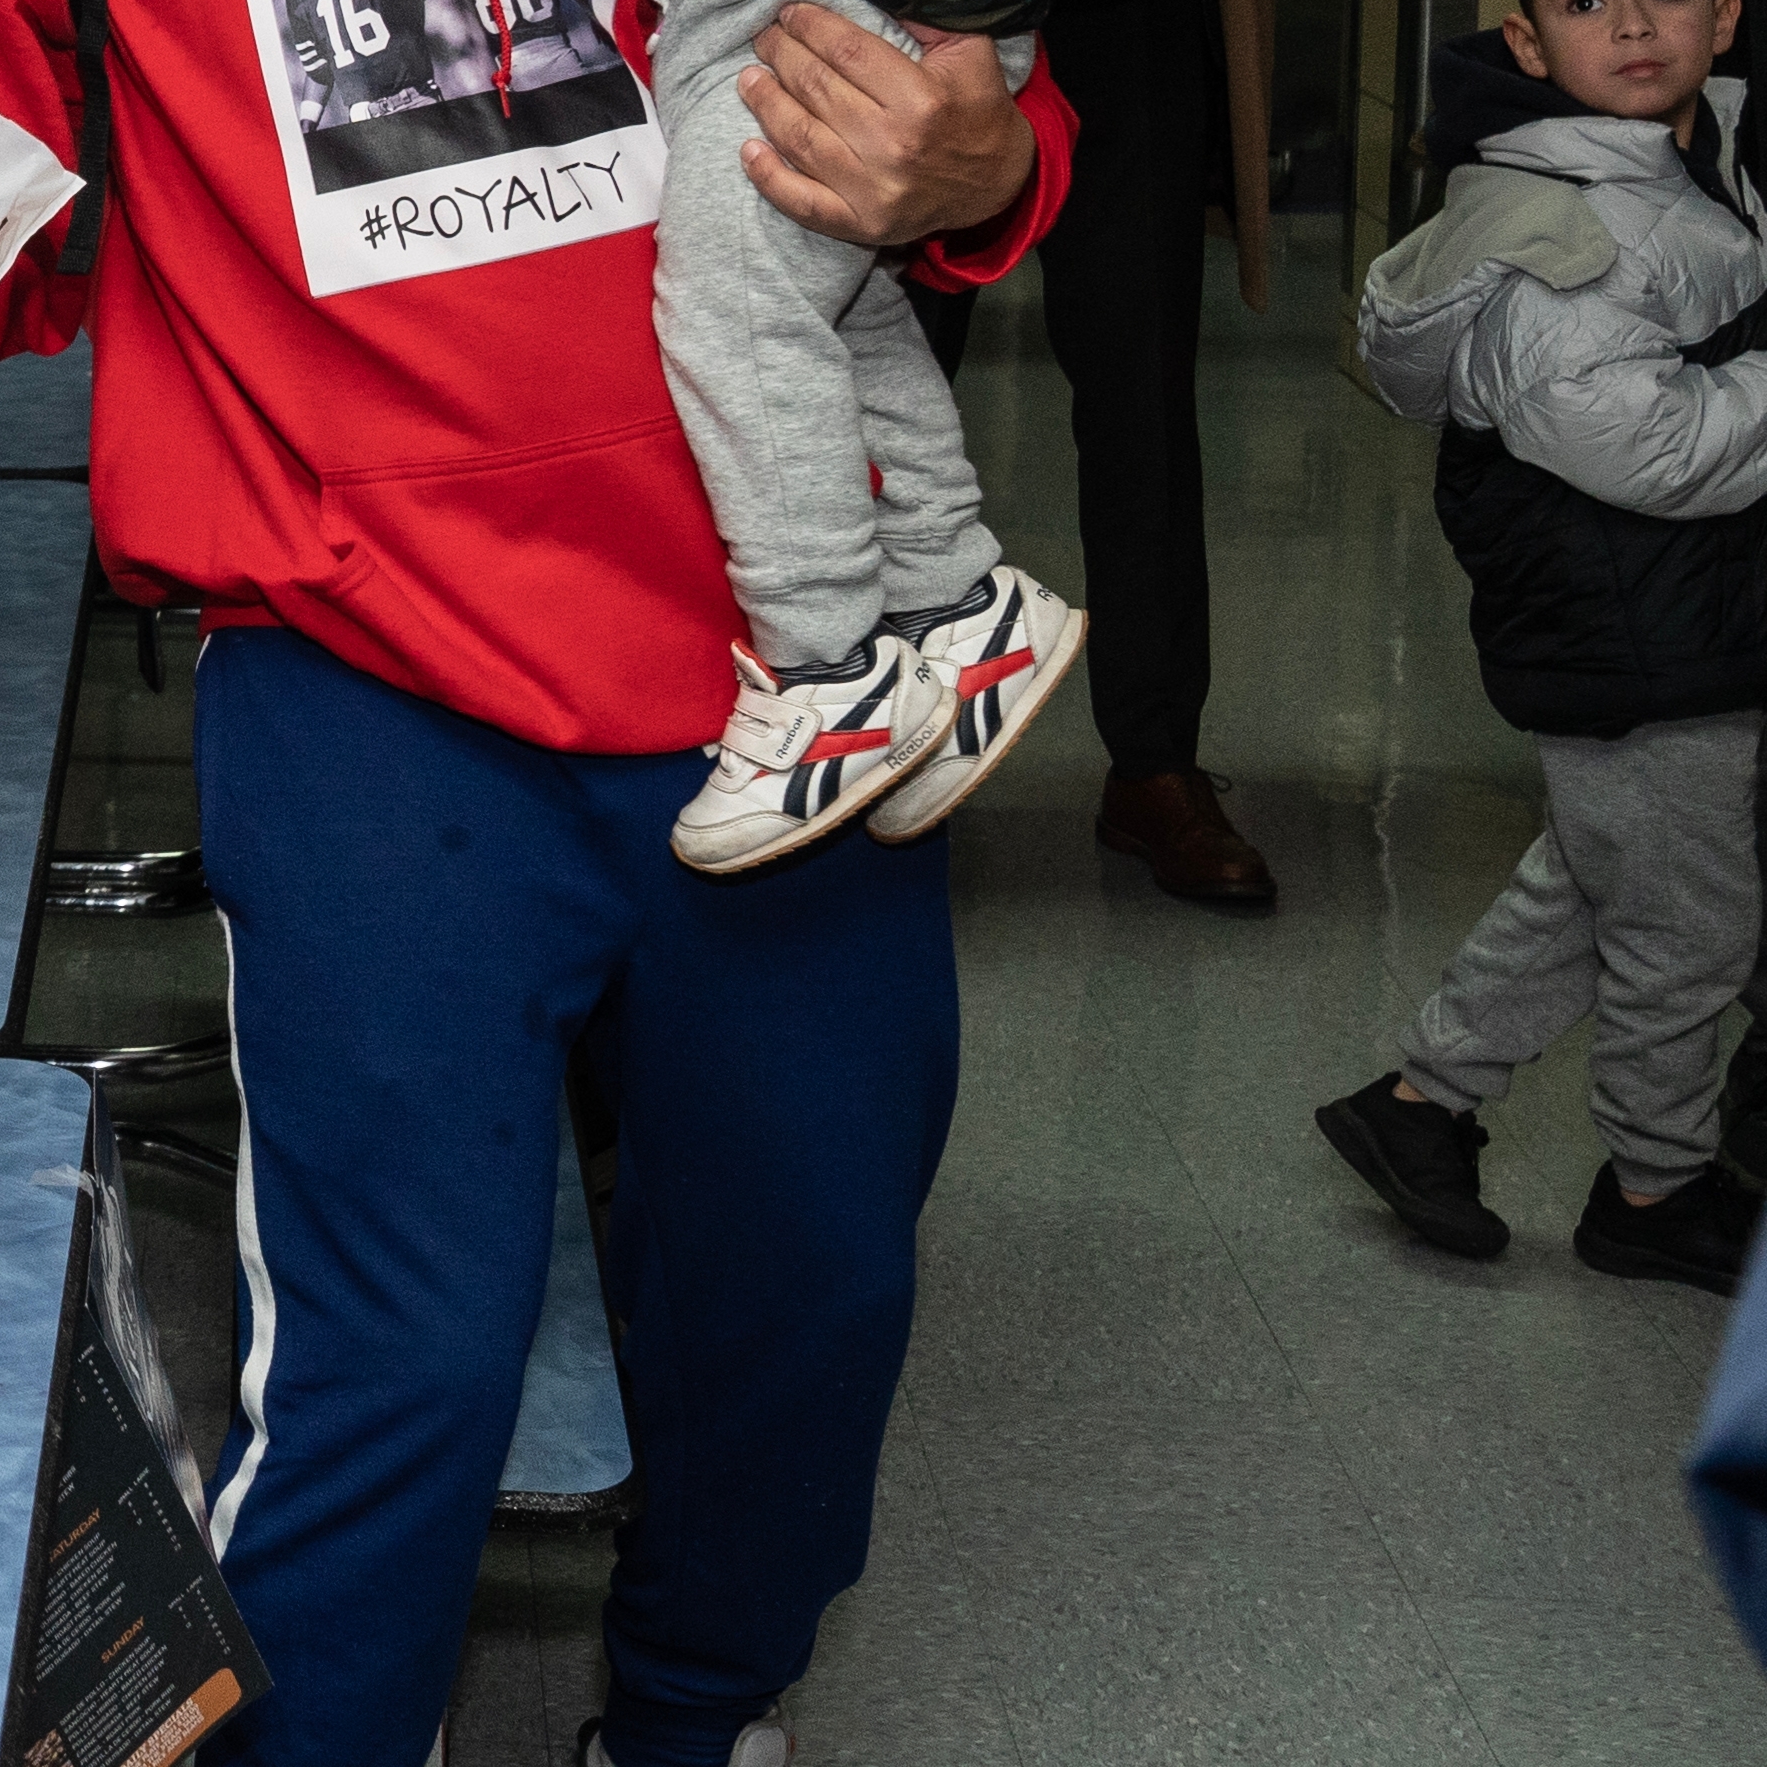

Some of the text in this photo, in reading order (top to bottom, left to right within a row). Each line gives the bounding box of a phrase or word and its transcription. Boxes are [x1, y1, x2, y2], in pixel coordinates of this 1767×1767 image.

[359, 152, 625, 250] #ROYALTY
[775, 715, 806, 760] Reebok
[884, 721, 941, 770] Reebok
[47, 1570, 72, 1597] HEARTY
[71, 1555, 89, 1574] MEAT
[88, 1538, 106, 1558] SOUP
[55, 1531, 101, 1577] CHICKEN SOUP
[89, 1540, 117, 1569] CHICKEN
[69, 1572, 97, 1601] CHICKEN
[95, 1554, 115, 1575] STEW
[73, 1589, 91, 1608] BEEF
[90, 1572, 109, 1593] STEW
[103, 1595, 122, 1616] STEW
[35, 1642, 62, 1670] OSTILLA
[93, 1594, 112, 1614] PORK
[53, 1618, 74, 1641] ROAST
[100, 1615, 145, 1664] SUNDAY
[58, 1707, 76, 1726] SOPA
[84, 1680, 106, 1702] POLLO
[107, 1651, 135, 1680] CHICKEN
[133, 1635, 151, 1654] SOUP
[67, 1719, 88, 1742] POLLO
[139, 1643, 167, 1672] CHICKEN
[99, 1673, 124, 1700] HEARTY
[124, 1692, 141, 1710] BEEF
[140, 1674, 160, 1695] STEW
[71, 1727, 92, 1750] POLLO
[120, 1674, 148, 1703] CHICKEN
[104, 1720, 125, 1741] ROAST
[122, 1697, 195, 1767] AILY SPECIALS
[166, 1734, 182, 1752] AND
